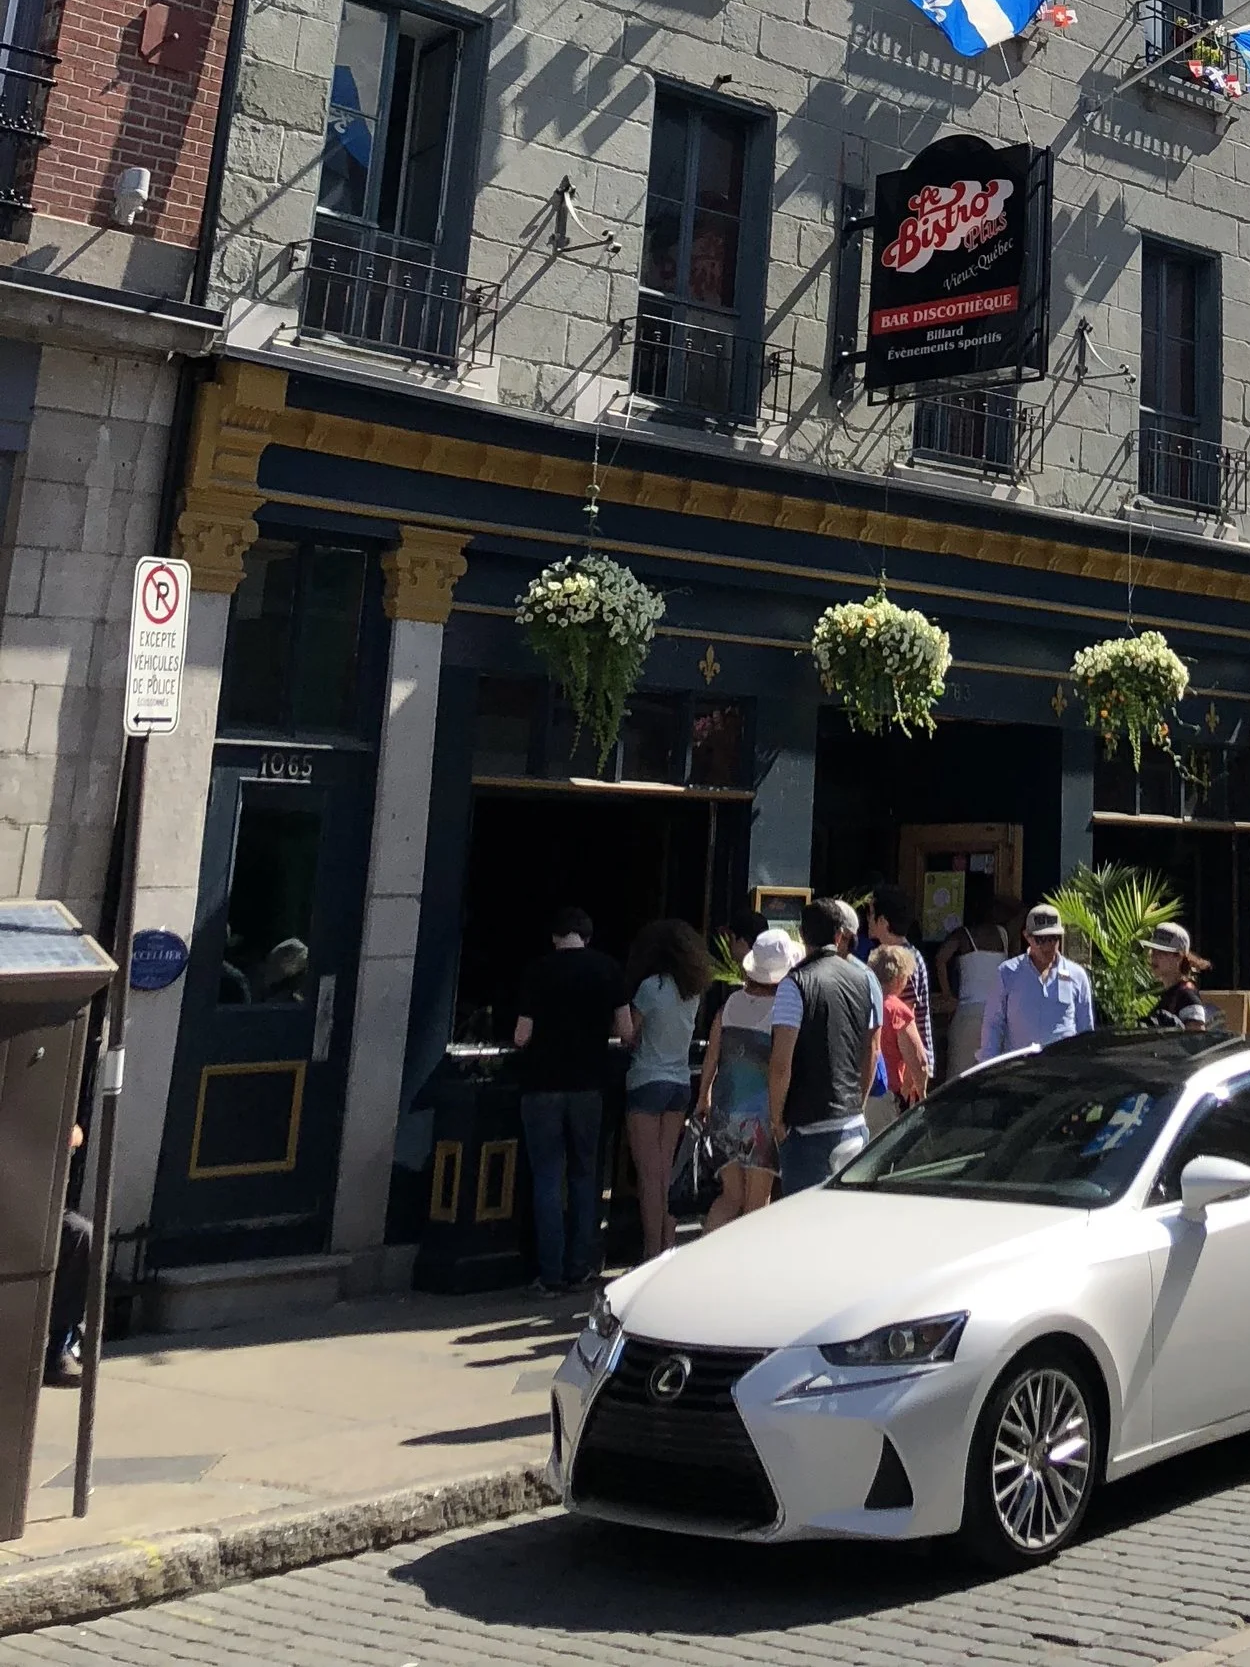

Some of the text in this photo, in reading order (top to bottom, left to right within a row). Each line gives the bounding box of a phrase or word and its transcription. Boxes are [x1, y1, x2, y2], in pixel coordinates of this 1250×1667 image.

[908, 185, 941, 216] Le
[881, 180, 1001, 269] Bistro
[963, 211, 1007, 253] Plus
[943, 237, 1014, 291] Vieux-Québec
[881, 294, 1012, 328] BAR DISCOTHÈQUE
[926, 325, 964, 342] Billard
[957, 331, 1003, 351] sportifs
[139, 630, 176, 649] EXCEPTÉ
[134, 653, 179, 672] VÉHICULES
[133, 678, 176, 695] DE POLICE
[261, 753, 312, 777] 1065
